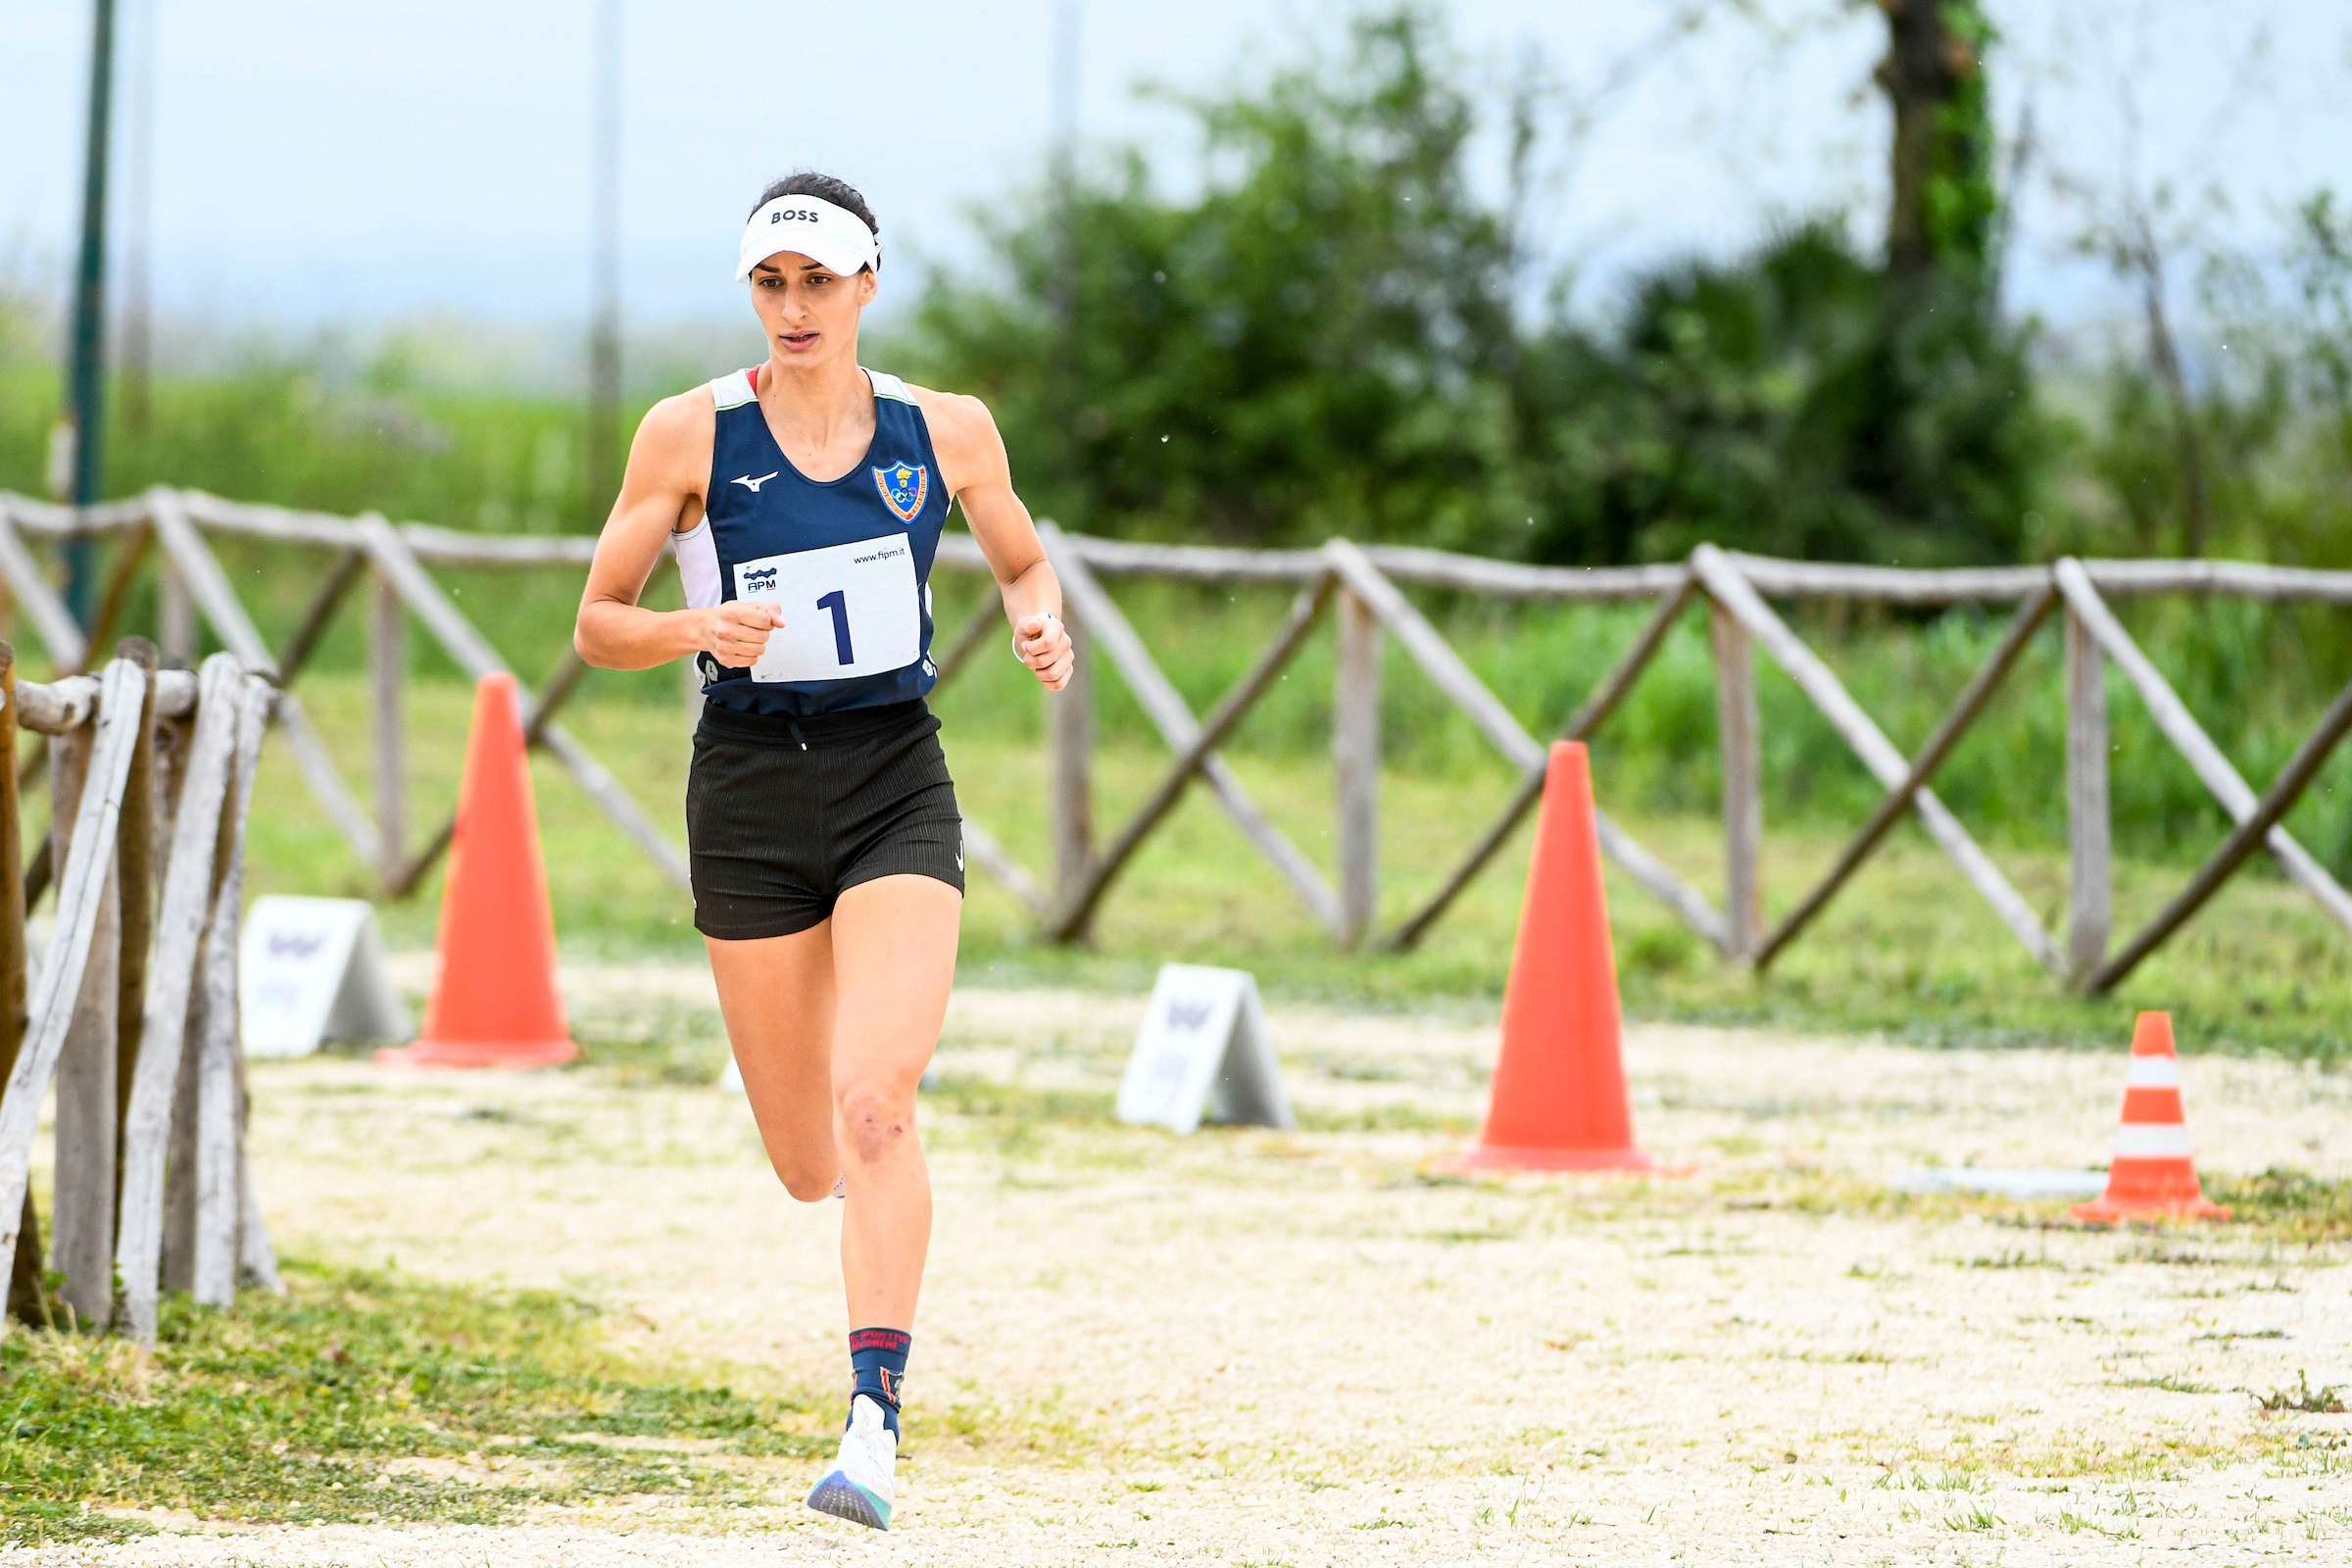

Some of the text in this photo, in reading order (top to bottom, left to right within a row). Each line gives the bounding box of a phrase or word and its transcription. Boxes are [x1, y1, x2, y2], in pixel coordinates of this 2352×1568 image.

[770, 209, 819, 224] BOSS
[854, 547, 906, 564] www.fipm.it
[816, 590, 854, 665] 1
